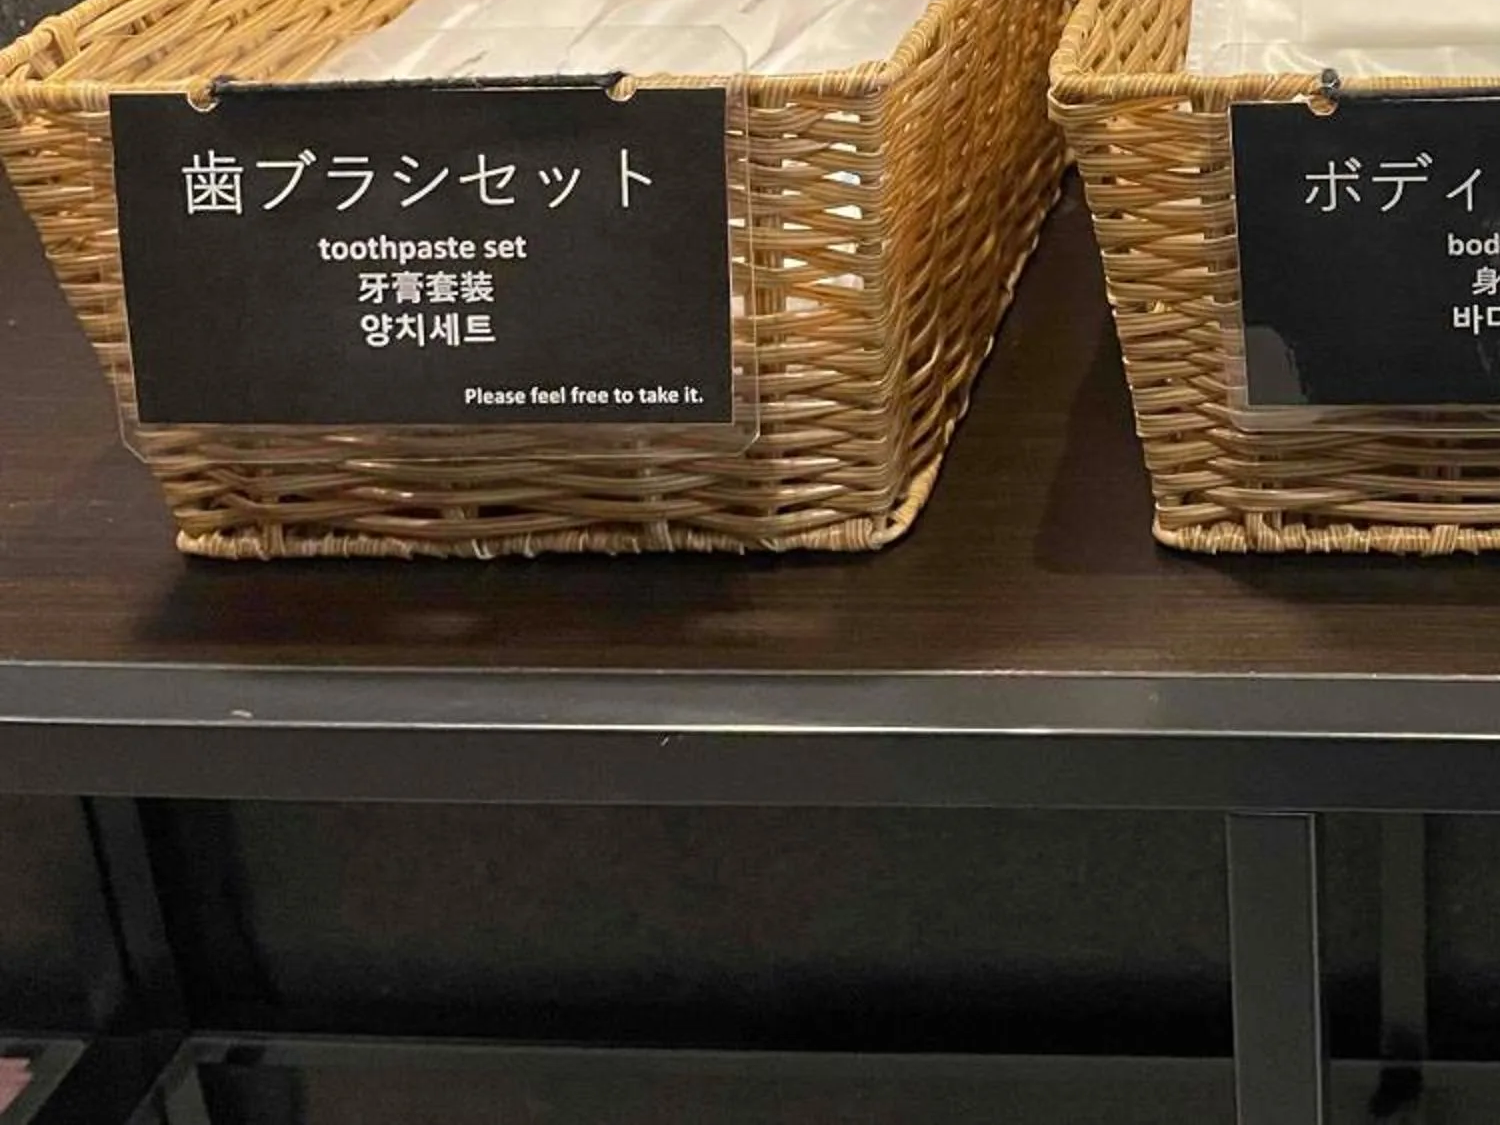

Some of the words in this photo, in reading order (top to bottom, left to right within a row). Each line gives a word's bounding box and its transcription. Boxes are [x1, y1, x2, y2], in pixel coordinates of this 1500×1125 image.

[181, 148, 652, 215] 歯ブラシセット
[317, 234, 476, 266] toothpaste
[483, 235, 528, 259] set
[357, 270, 495, 305] 牙膏套装
[359, 312, 497, 348] 양치세트
[464, 386, 527, 405] Please
[529, 386, 566, 404] feel
[570, 386, 609, 404] free
[612, 387, 635, 404] to
[637, 385, 680, 404] take
[683, 385, 704, 404] it.
